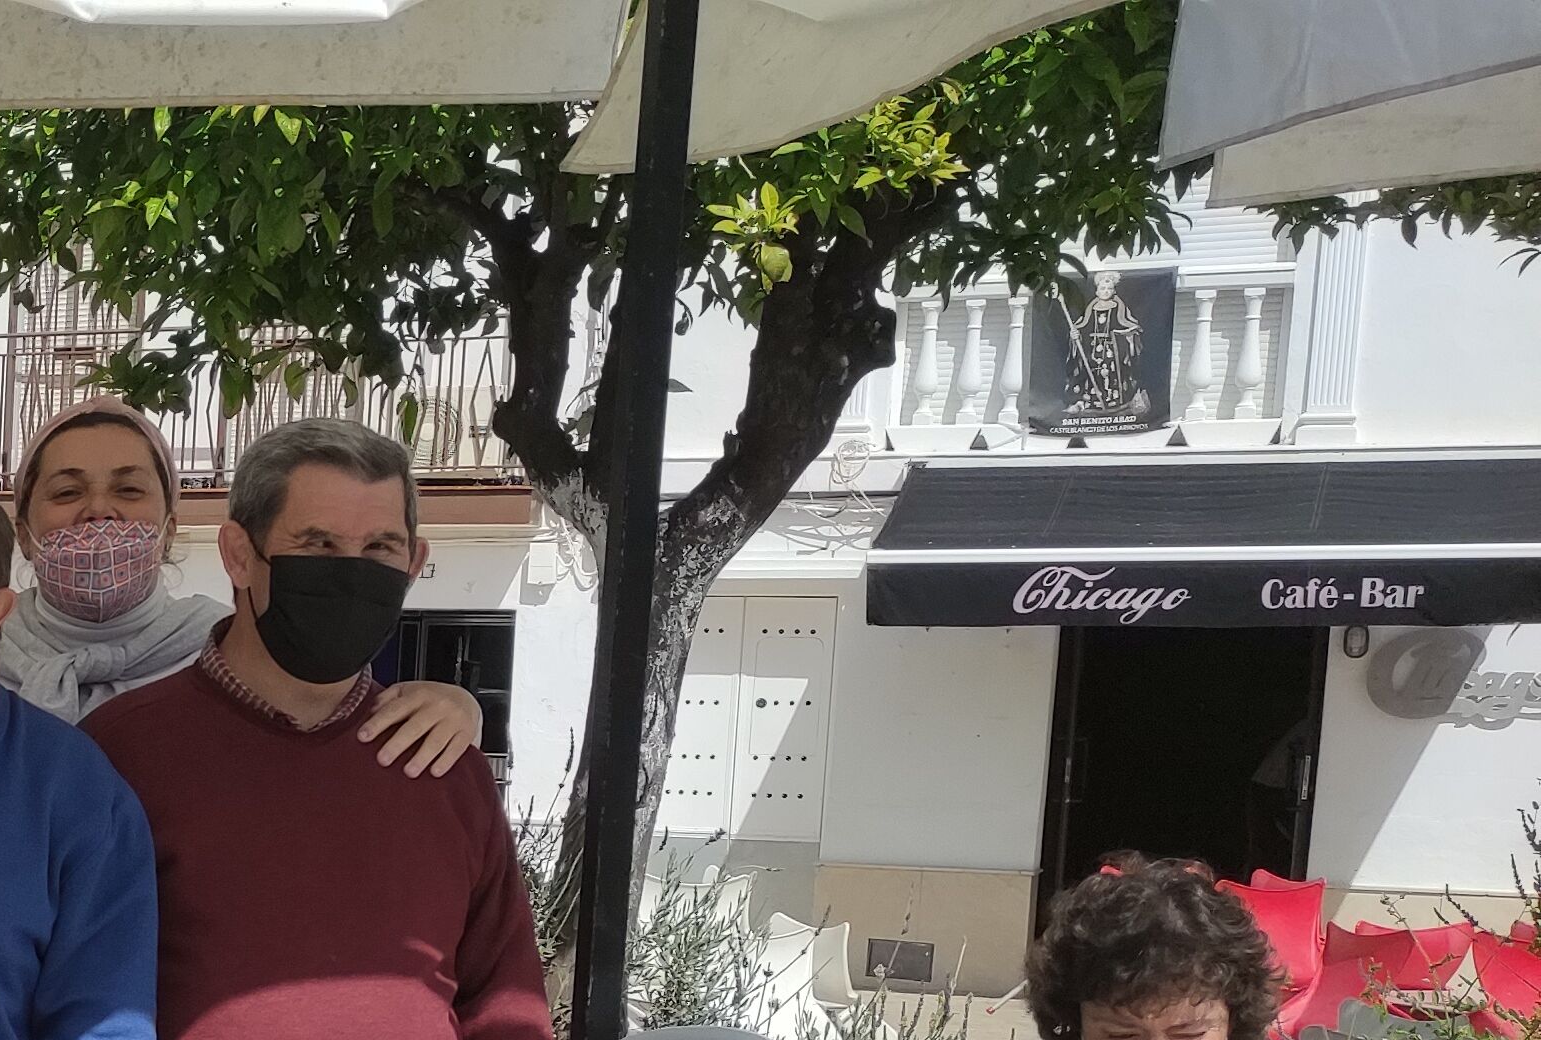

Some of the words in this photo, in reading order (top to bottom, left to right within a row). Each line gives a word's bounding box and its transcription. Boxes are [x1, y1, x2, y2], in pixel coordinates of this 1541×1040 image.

[1062, 418, 1079, 426] SAN
[1081, 417, 1112, 425] BENITO
[1012, 566, 1192, 625] Chicago
